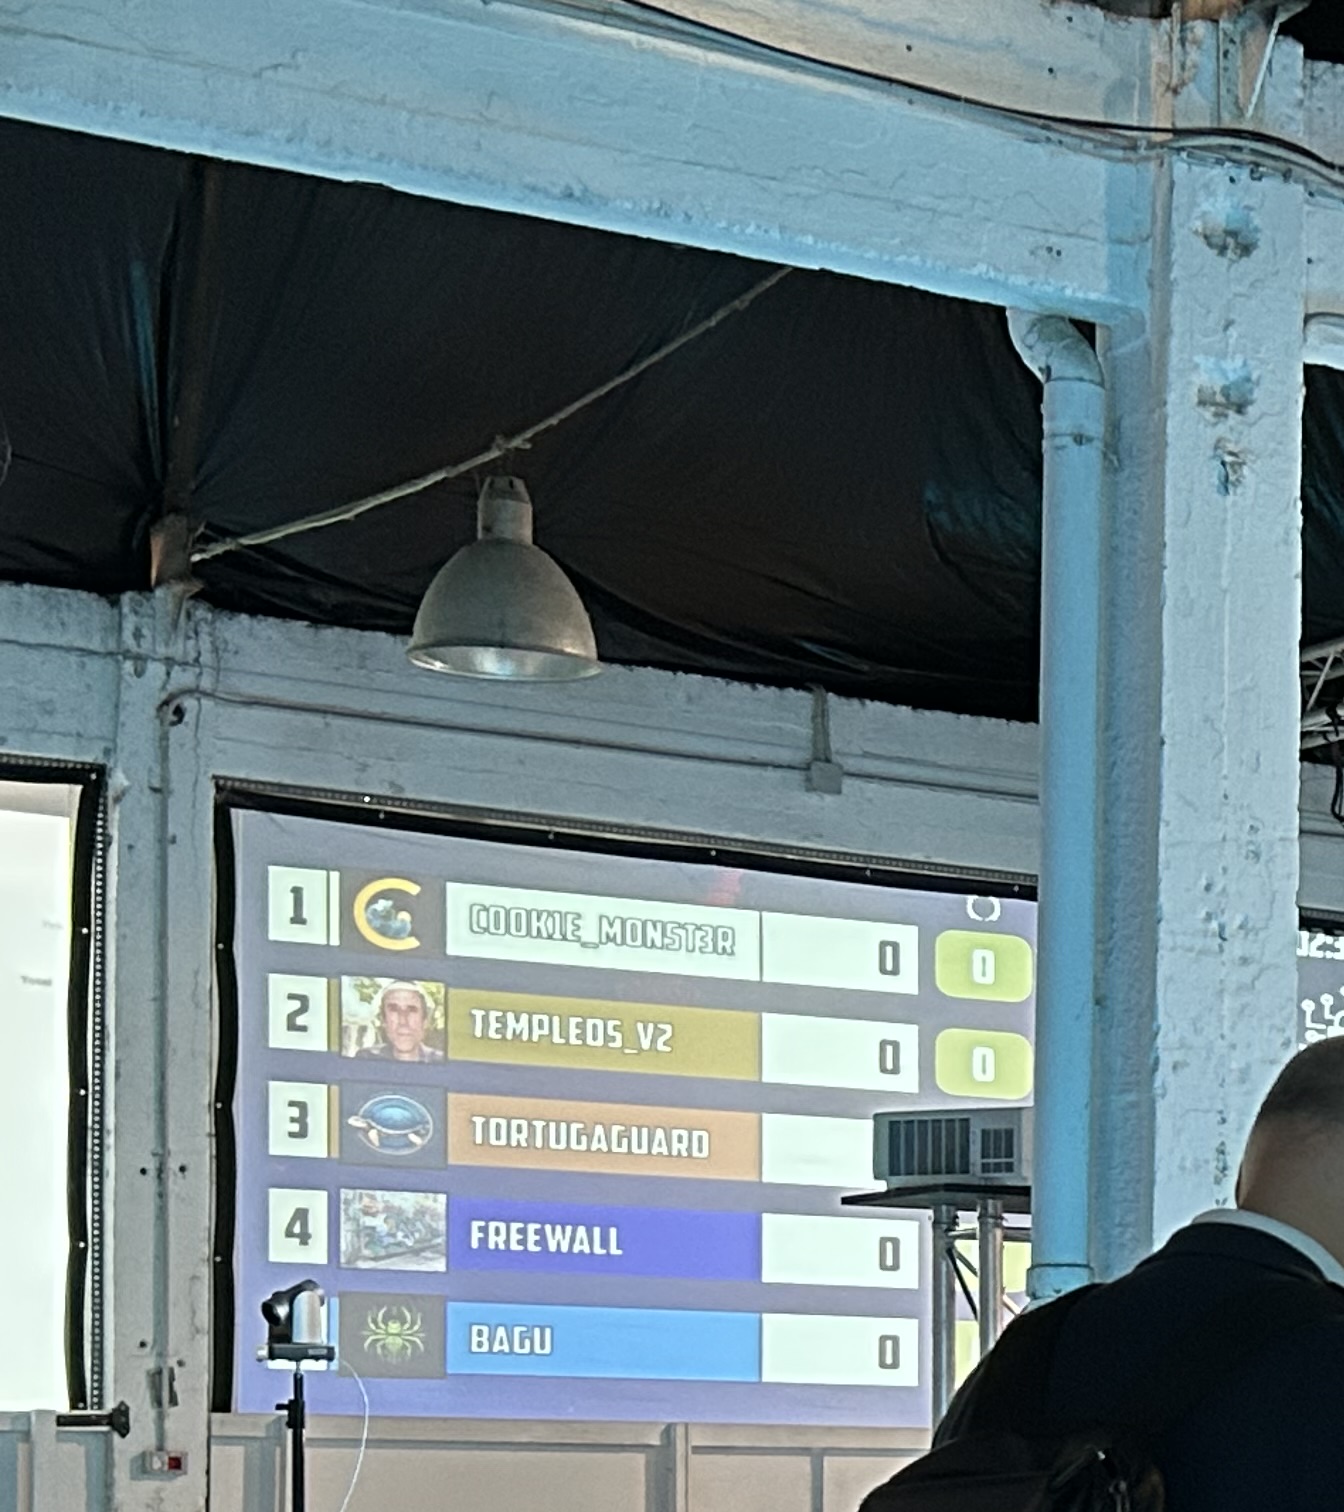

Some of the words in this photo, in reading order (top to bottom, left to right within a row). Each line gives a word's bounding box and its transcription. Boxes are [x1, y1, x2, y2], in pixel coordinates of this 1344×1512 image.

[289, 885, 308, 926] 1
[879, 939, 900, 977] 0
[972, 948, 995, 985] 0
[286, 992, 310, 1033] 2
[470, 1008, 673, 1054] TEMPLEOS_V2
[879, 1038, 901, 1075] 0
[972, 1046, 995, 1082] 0
[287, 1099, 309, 1139] 3
[471, 1116, 710, 1159] TORTUGAGUARD
[284, 1206, 312, 1247] 4
[470, 1219, 623, 1255] FREEWALL
[879, 1235, 901, 1272] 0
[470, 1324, 552, 1355] BAGU
[878, 1334, 901, 1370] 0
